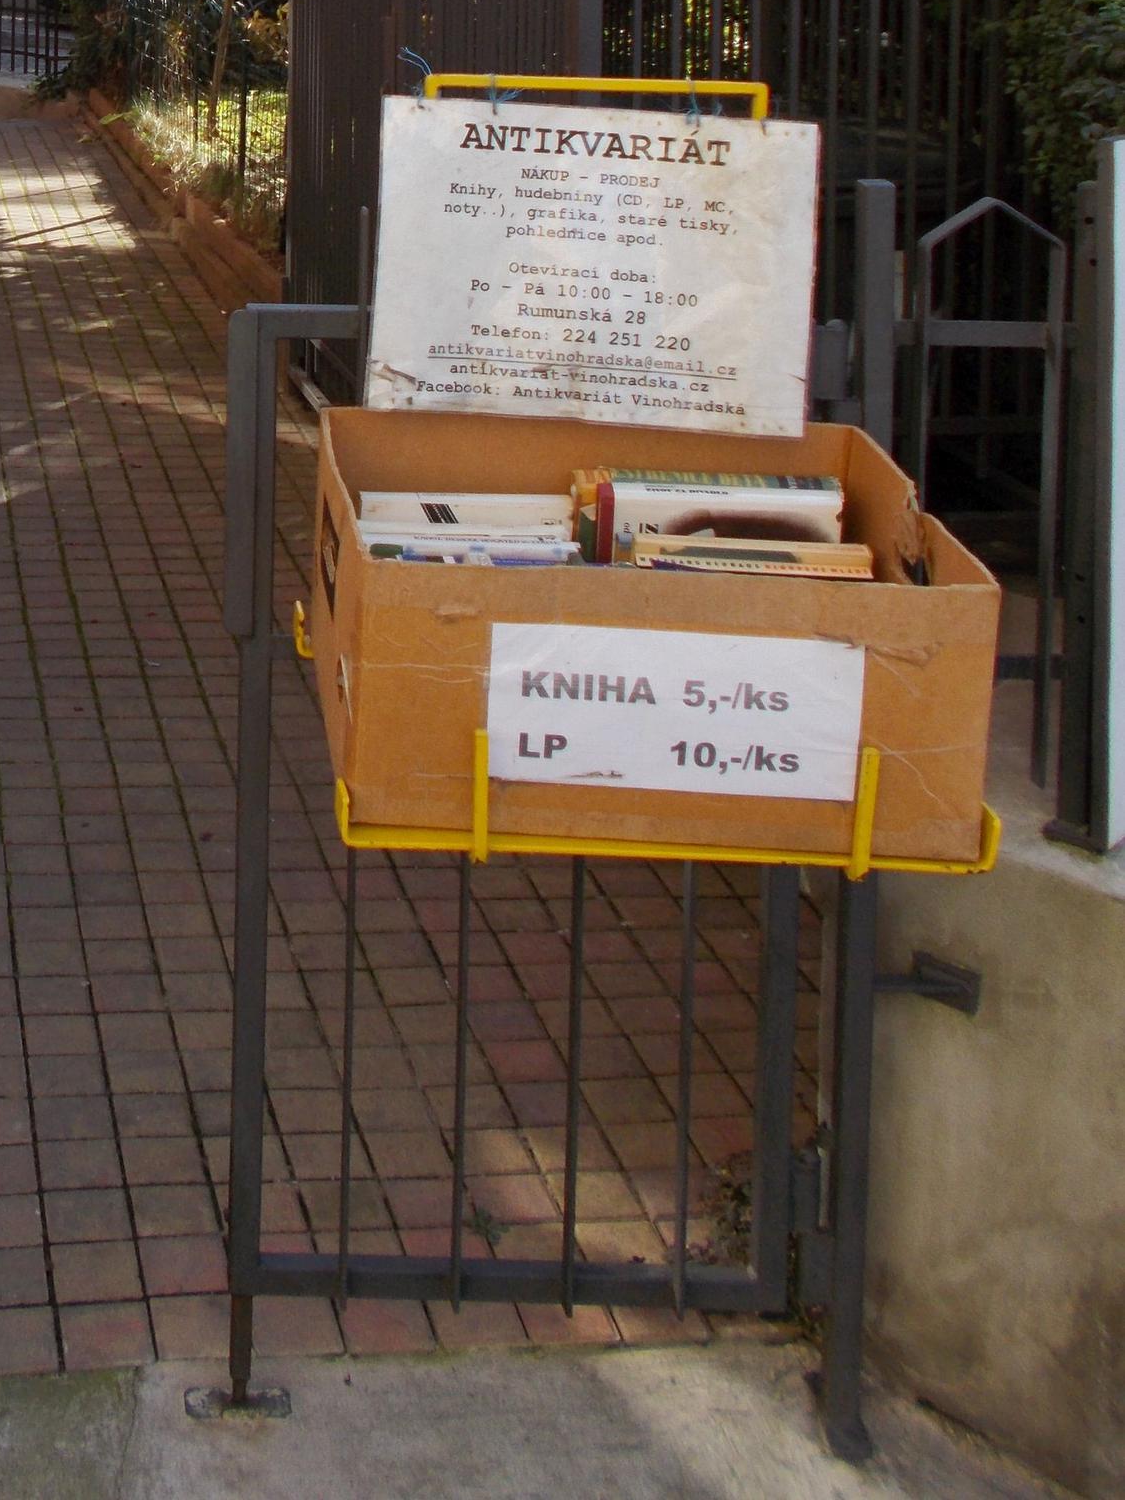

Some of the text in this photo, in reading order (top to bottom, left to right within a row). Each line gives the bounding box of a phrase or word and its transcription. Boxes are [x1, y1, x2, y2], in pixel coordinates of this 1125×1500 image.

[459, 124, 731, 166] ANTIKVARIÁT
[521, 165, 570, 181] NÁKUP
[600, 173, 661, 188] PRODEJ
[449, 182, 734, 215] Knihy, hudebniny (CD, LP, MC,
[506, 224, 663, 248] pohlednice apod.
[527, 206, 605, 224] grafika,
[618, 212, 667, 228] staré
[679, 216, 738, 236] tisky,
[509, 262, 656, 284] Otevírací doba:
[471, 279, 490, 292] Po
[524, 282, 545, 296] Pá
[558, 285, 611, 301] 10:00
[644, 291, 698, 307] 18:00
[517, 304, 646, 325] Rumunská 28
[471, 324, 690, 351] Telefon: 224 251 220
[428, 343, 737, 376] antikvariatvinohradska@email.cz
[416, 380, 746, 415] Facebook: Antikvariát Vinohradská
[521, 670, 789, 715] KNIHA 5,-/ks
[518, 732, 800, 776] LP 10,-/ks
